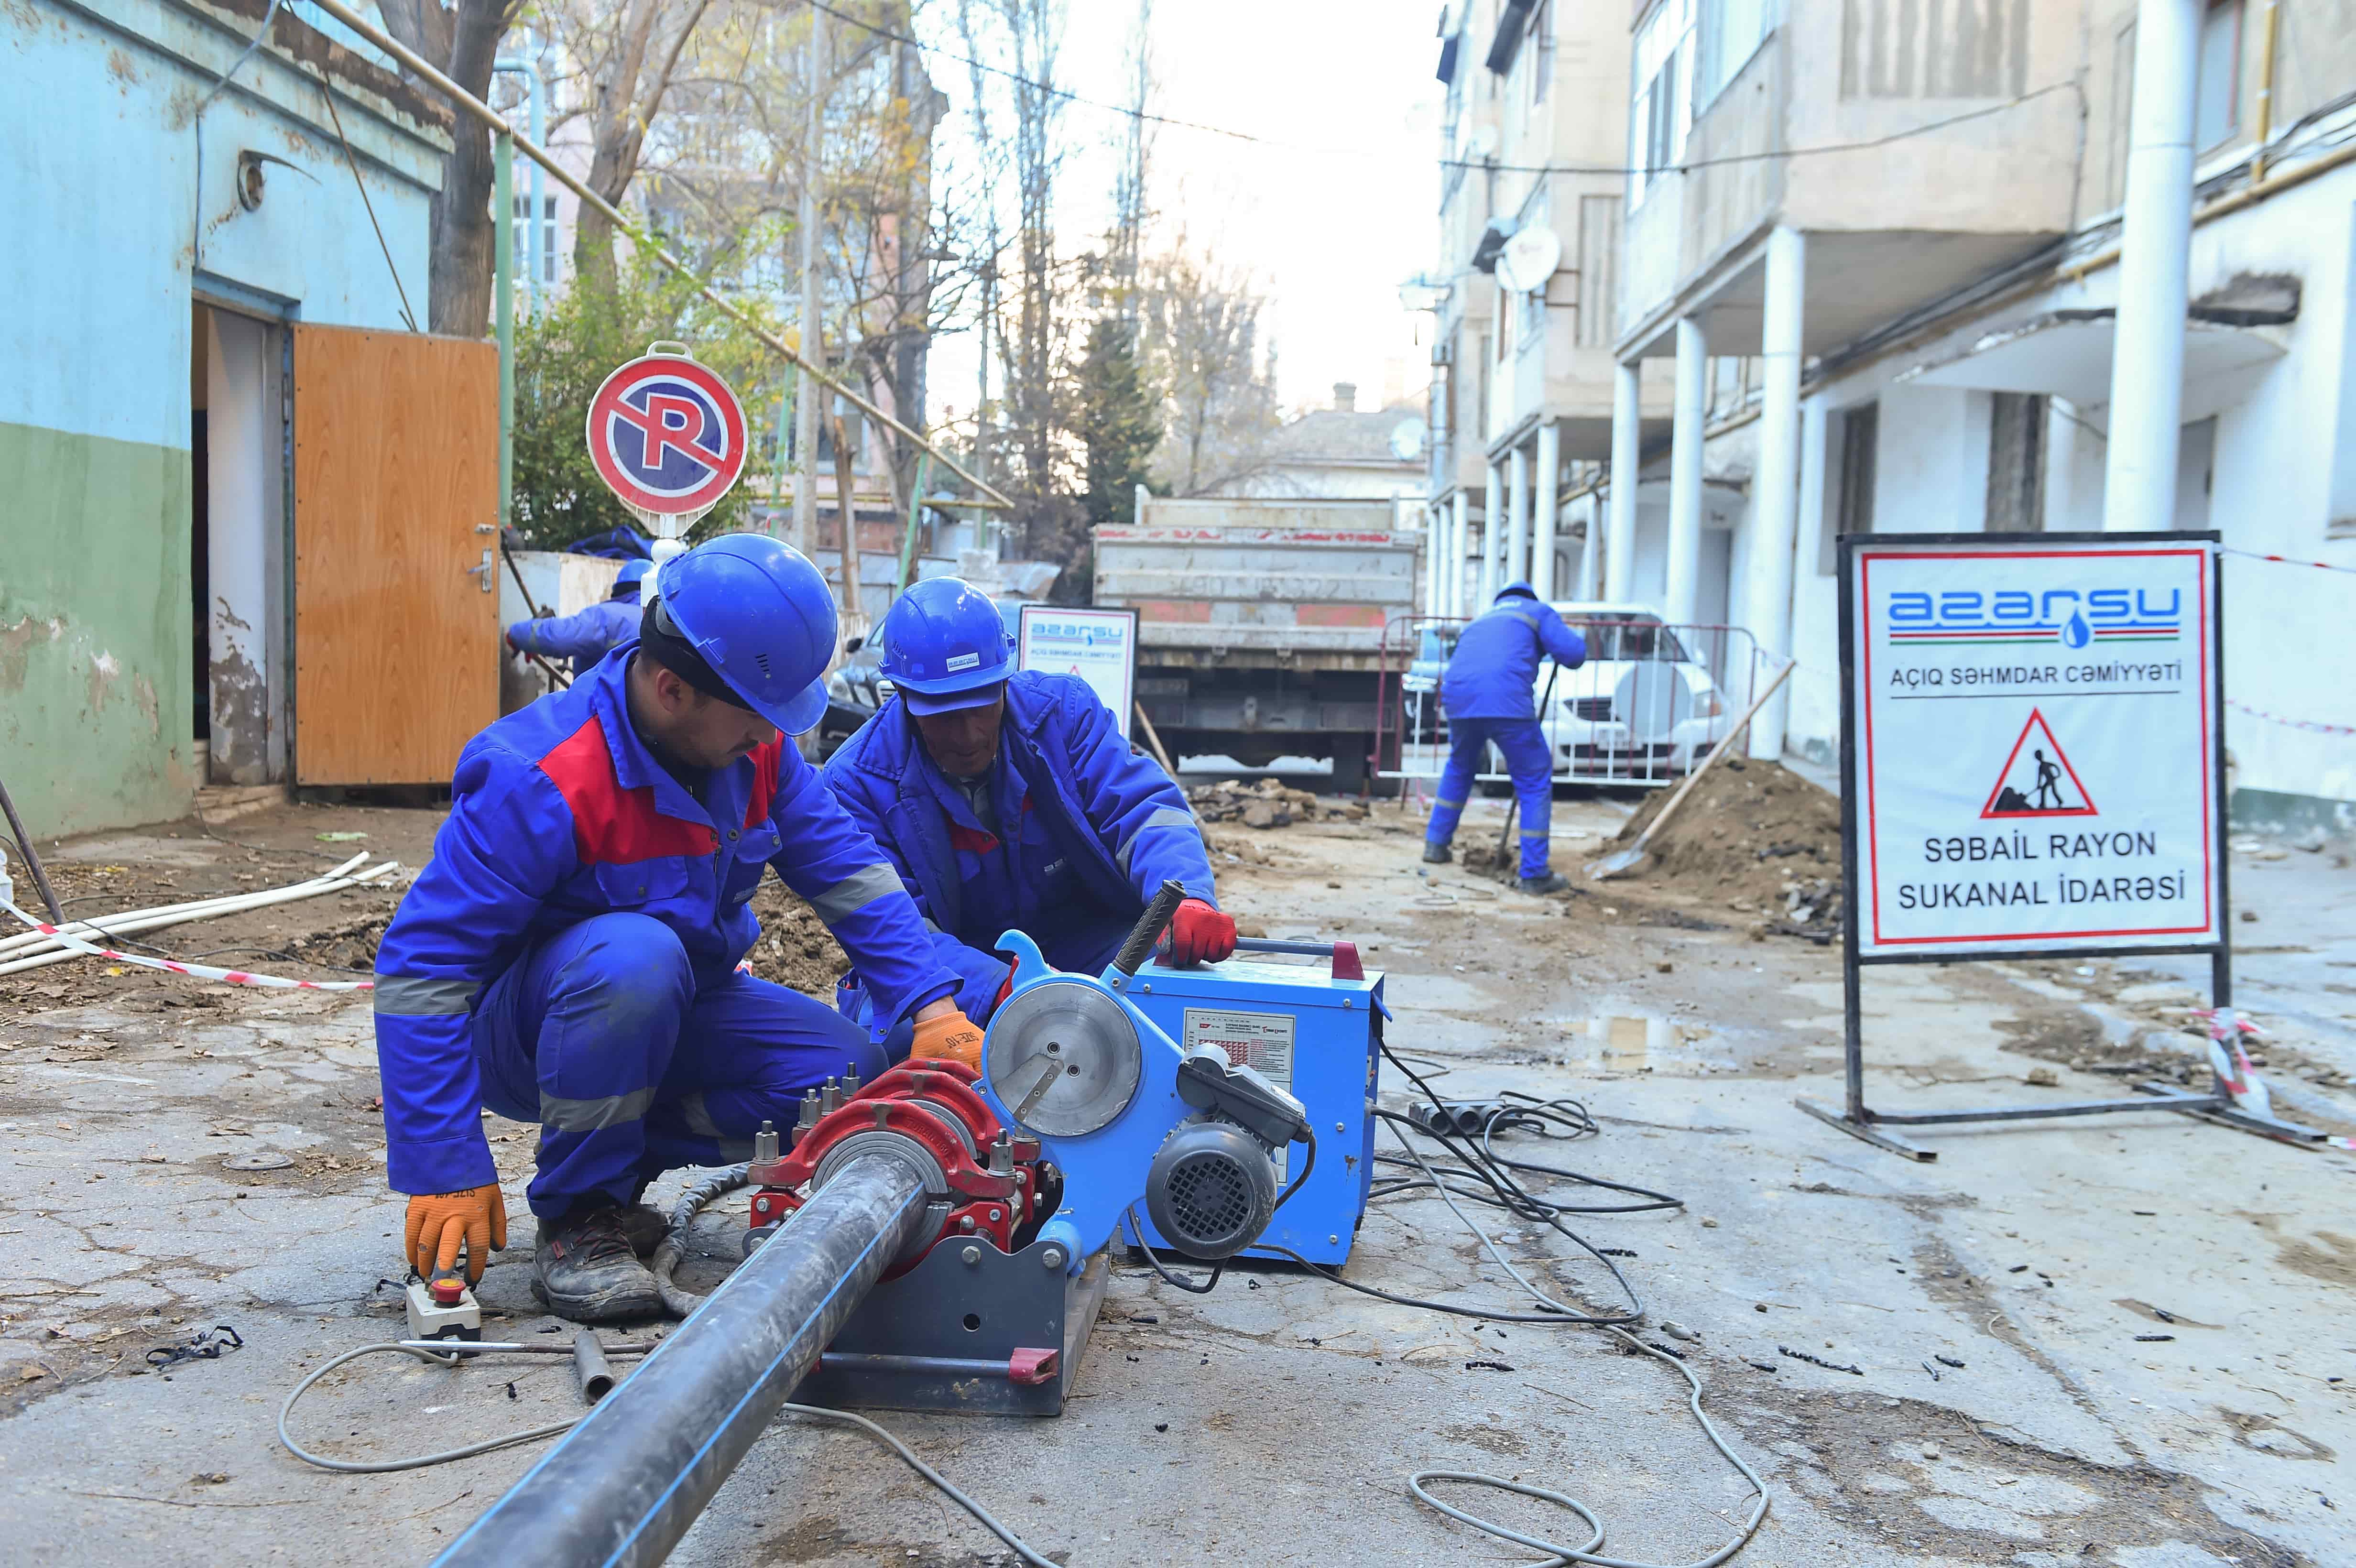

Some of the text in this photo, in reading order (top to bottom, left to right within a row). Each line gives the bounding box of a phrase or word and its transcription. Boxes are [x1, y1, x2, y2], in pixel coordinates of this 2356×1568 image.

[1888, 588, 2180, 620] azarsu
[1032, 624, 1122, 637] azarsu
[1890, 660, 2182, 691] AÇIQ SƏHMDAR CƏMİYYƏTİ
[1925, 829, 2156, 862] SƏBAİL RAYON
[1899, 870, 2185, 909] SUKANAL İDARƏSİ
